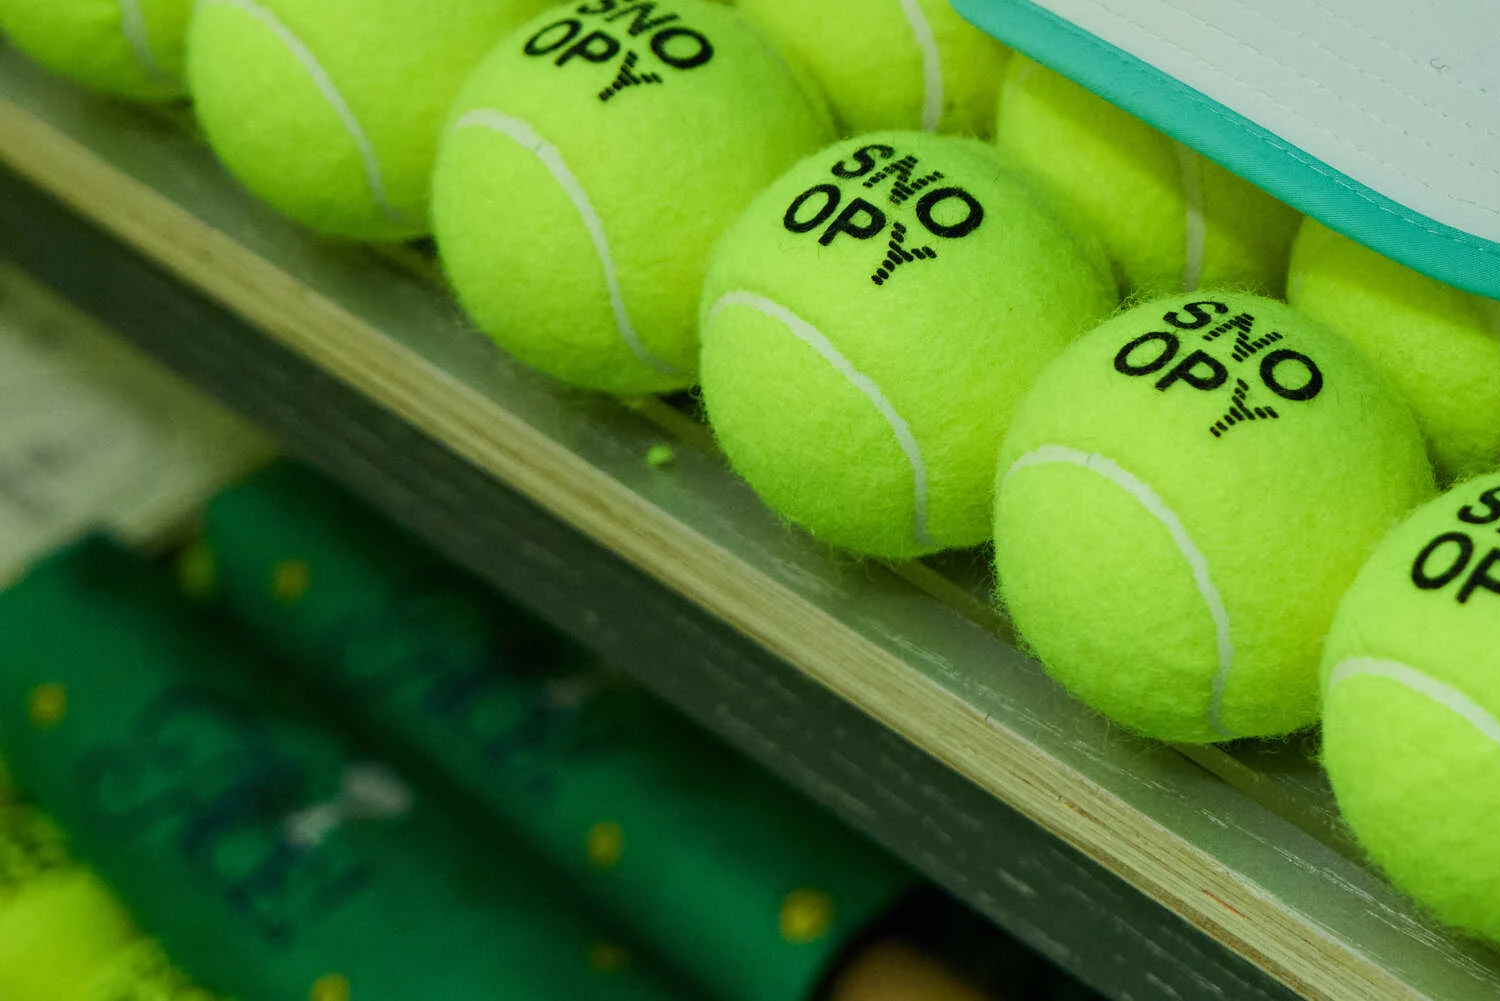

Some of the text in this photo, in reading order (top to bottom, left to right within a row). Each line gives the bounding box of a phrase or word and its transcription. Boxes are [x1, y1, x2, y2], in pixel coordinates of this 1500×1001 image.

[524, 19, 662, 101] OPY
[783, 184, 937, 286] OPY
[831, 144, 984, 239] SNO
[1113, 331, 1279, 438] OPY
[1162, 300, 1324, 401] SNO
